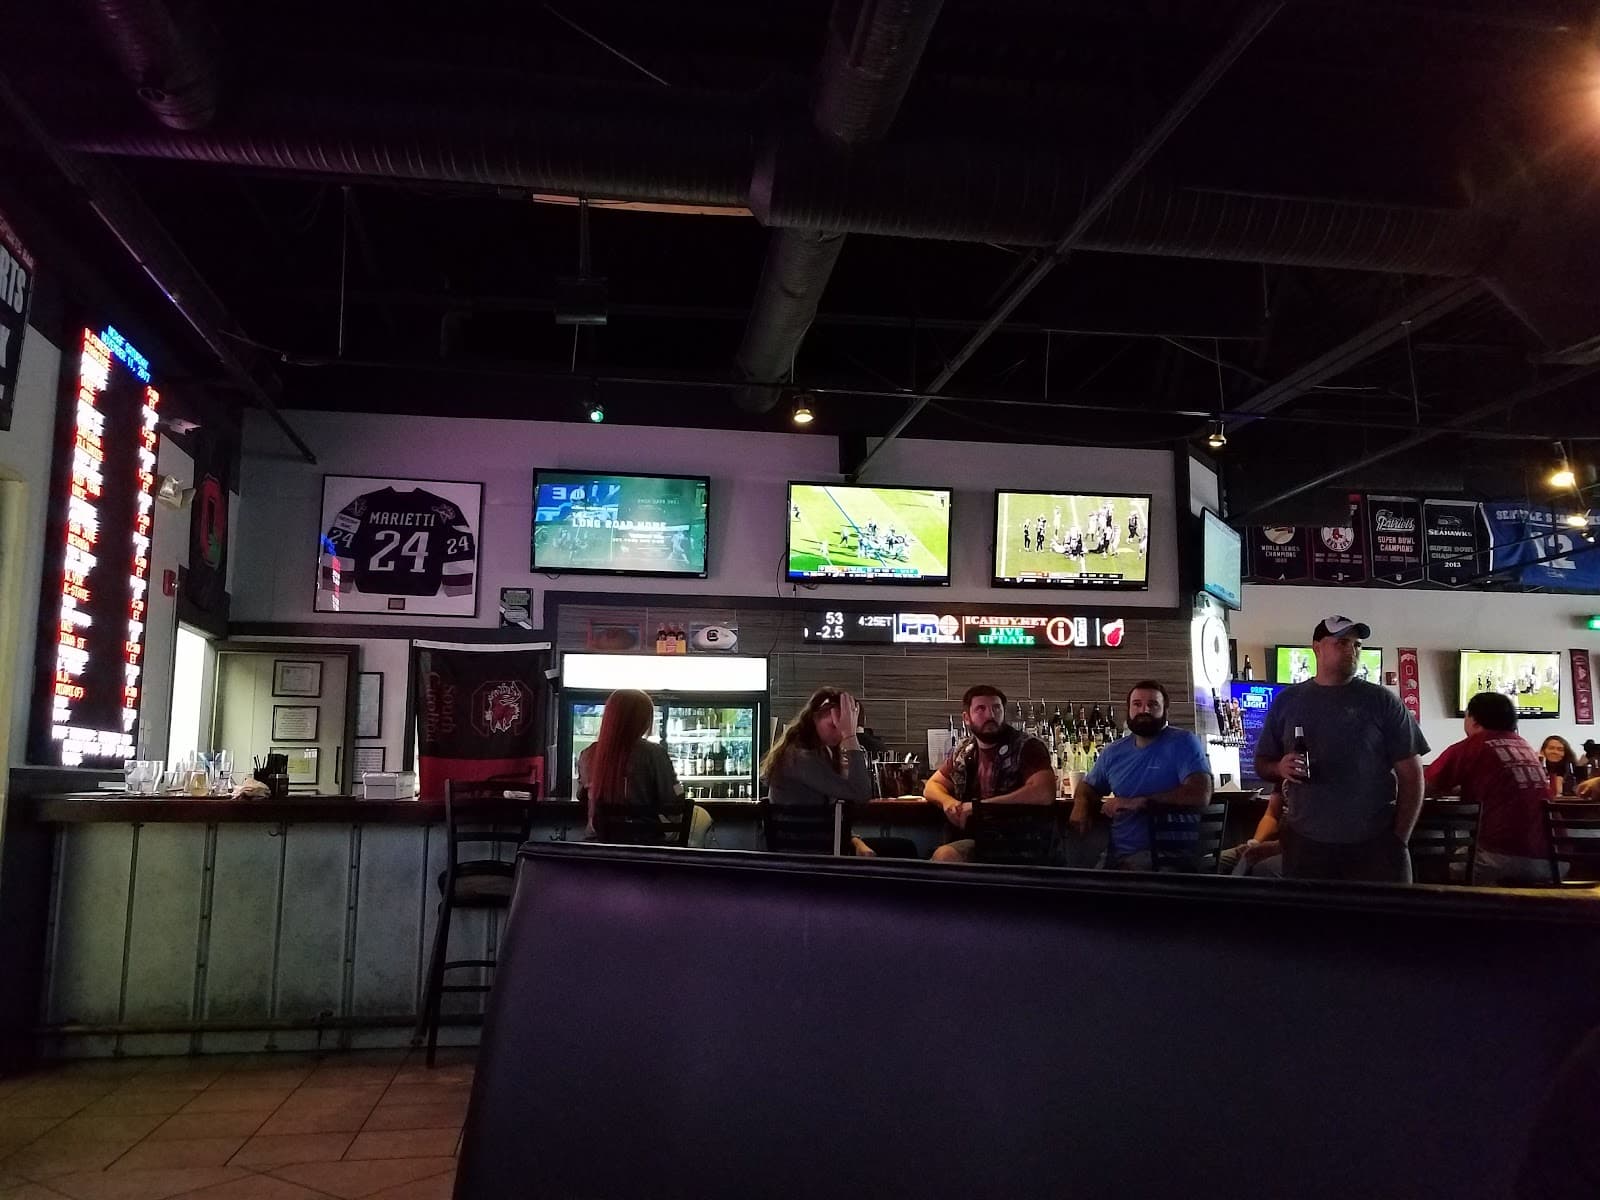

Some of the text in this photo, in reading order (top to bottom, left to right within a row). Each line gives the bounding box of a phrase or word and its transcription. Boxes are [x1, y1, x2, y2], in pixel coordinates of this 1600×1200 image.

[368, 512, 436, 527] MARIETTI
[1428, 529, 1473, 537] SEAHAWKS
[446, 535, 470, 555] 24
[1377, 535, 1416, 545] SUPER BOWL
[368, 530, 430, 573] 24
[1429, 545, 1452, 553] SUPER
[825, 611, 844, 625] 53
[858, 615, 893, 627] 4:25ET
[815, 625, 844, 639] -2.5
[990, 627, 1024, 636] LIVE
[979, 634, 1035, 644] UPDATE
[1243, 701, 1266, 709] LIGHT
